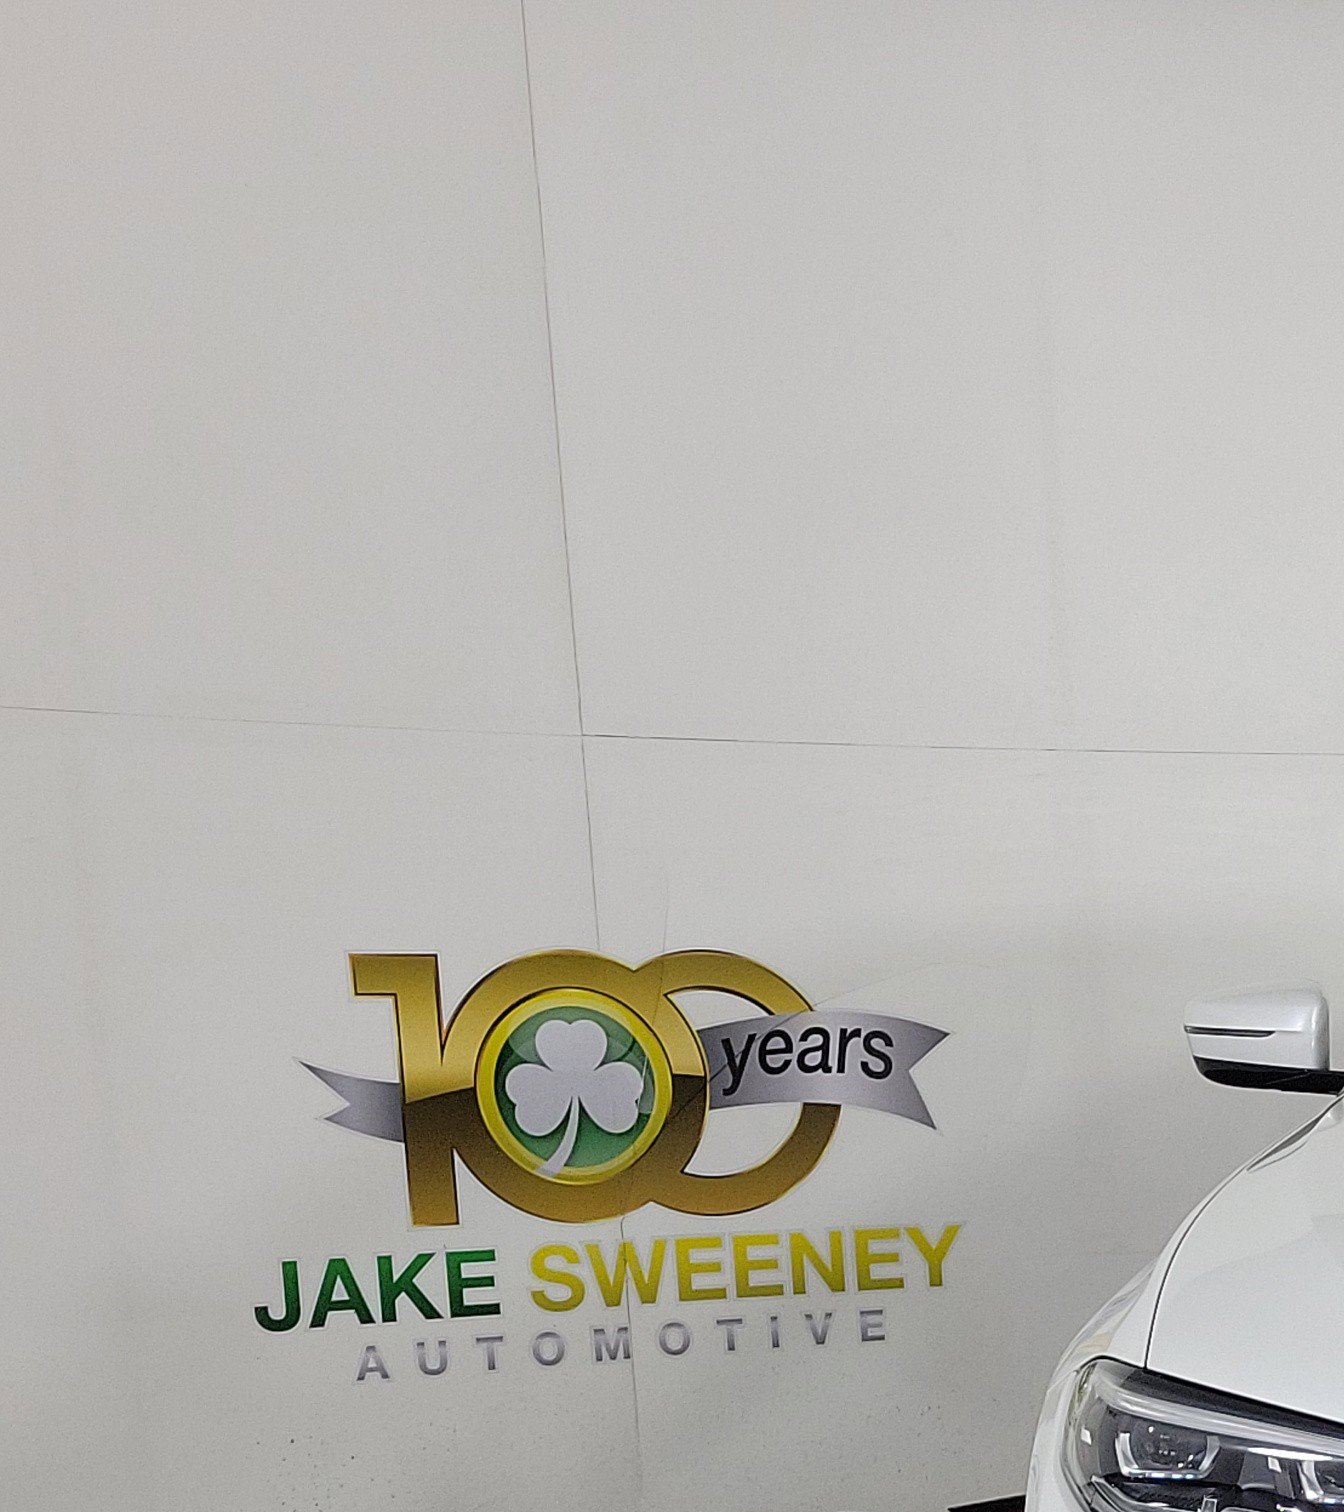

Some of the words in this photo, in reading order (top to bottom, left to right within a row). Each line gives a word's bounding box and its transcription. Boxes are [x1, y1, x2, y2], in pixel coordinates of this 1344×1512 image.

[348, 948, 842, 1226] 100
[721, 1022, 895, 1096] years
[253, 1248, 501, 1333] JAKE
[529, 1224, 963, 1313] SWEENEY
[355, 1309, 886, 1383] AUTOMOTIVE
